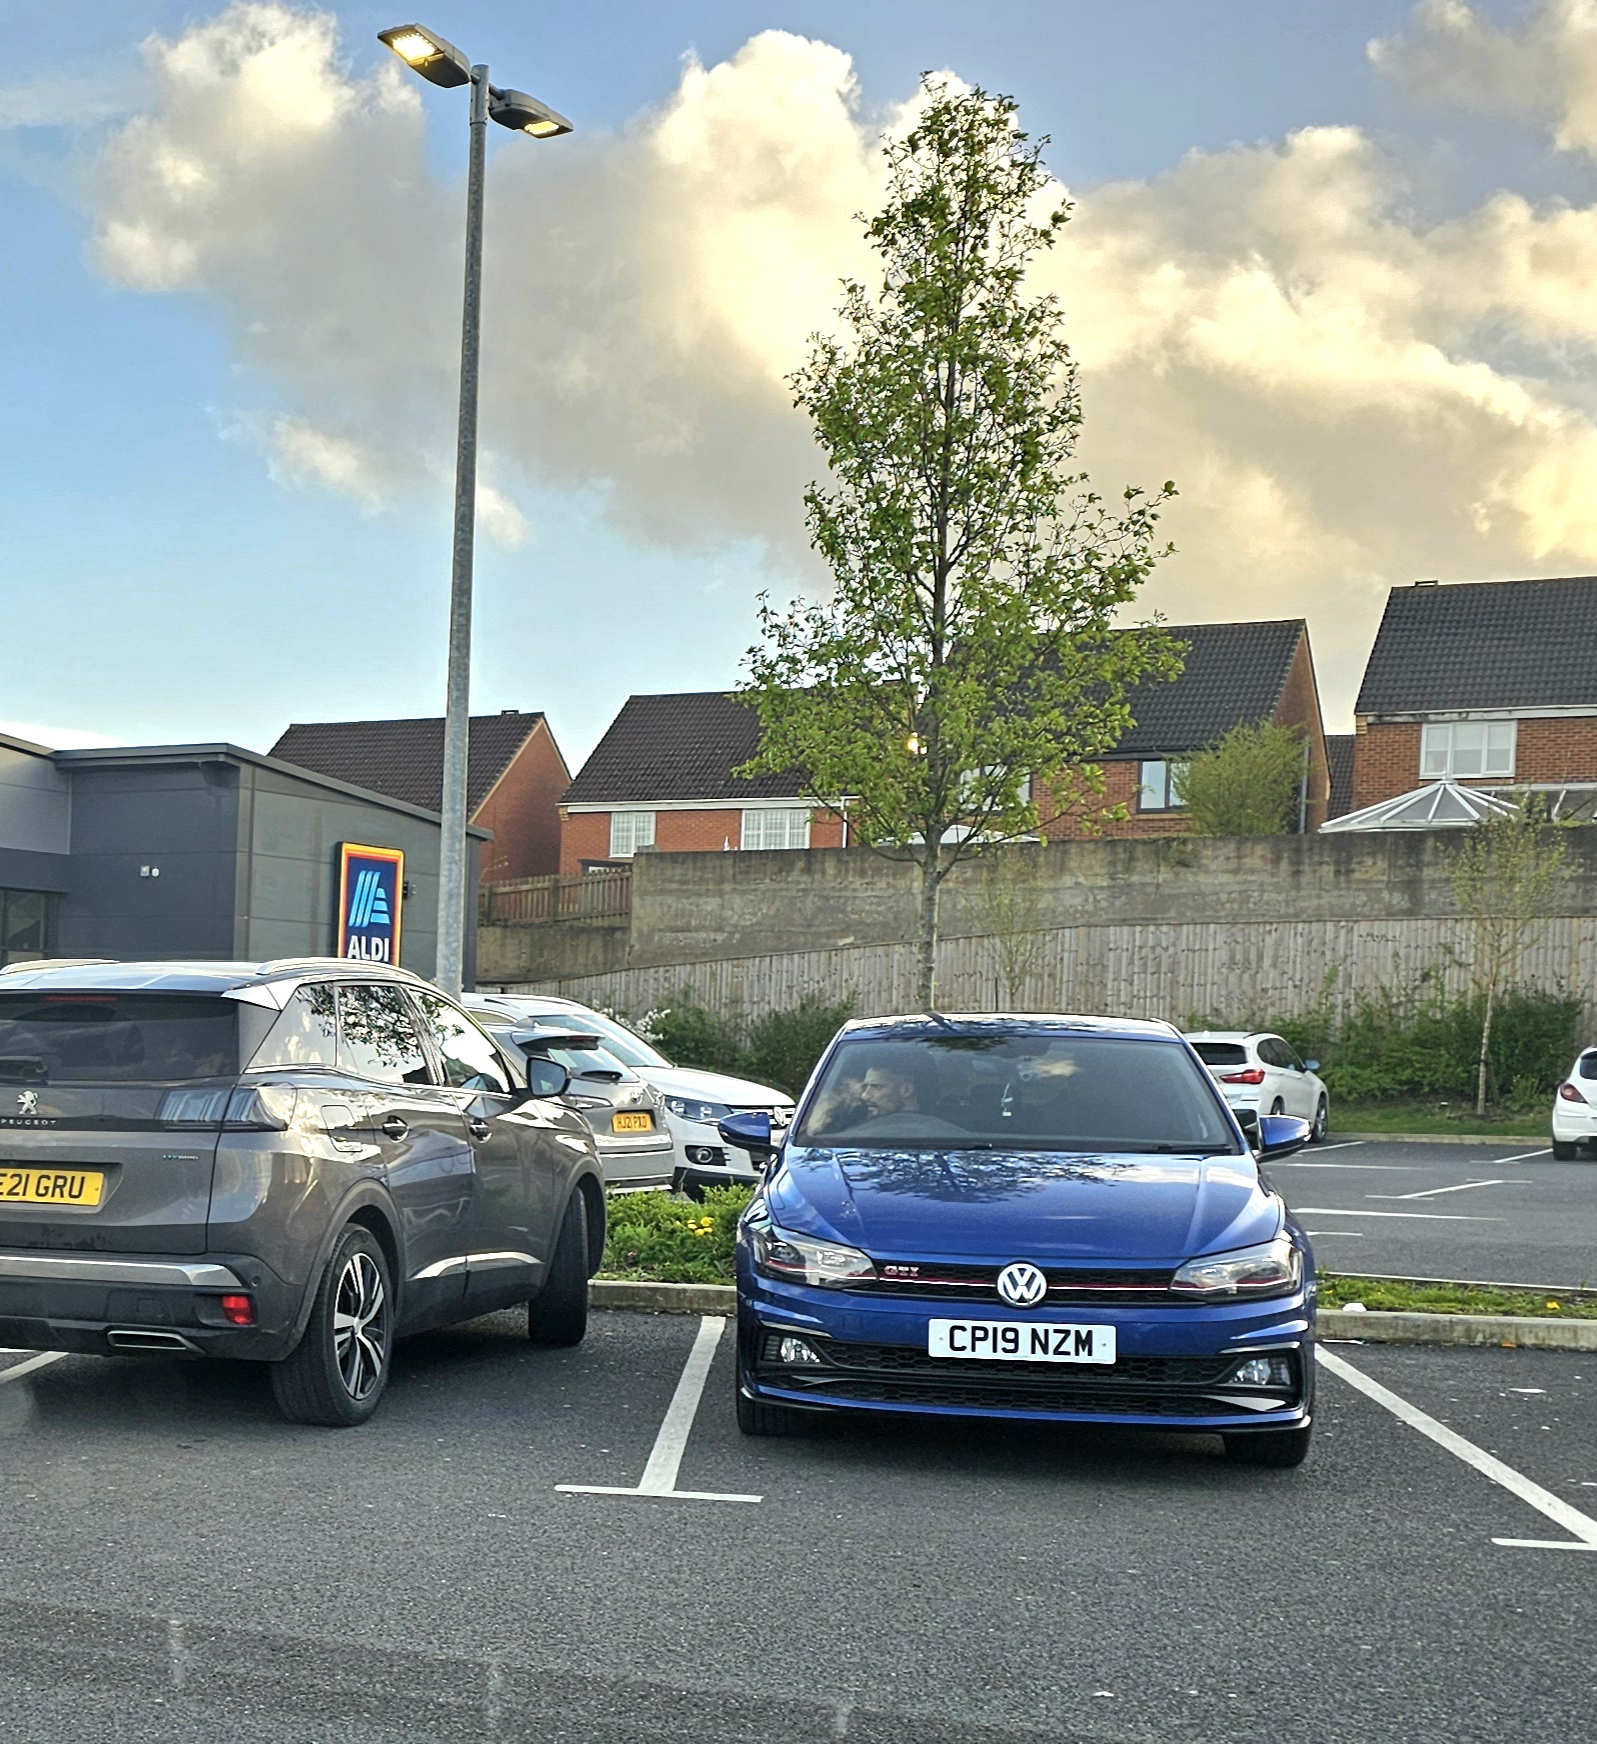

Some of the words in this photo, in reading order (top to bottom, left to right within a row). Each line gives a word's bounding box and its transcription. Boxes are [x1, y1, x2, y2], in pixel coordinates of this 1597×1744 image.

[346, 934, 391, 962] ALDI
[0, 1118, 57, 1126] PEUGEOT
[34, 1176, 86, 1199] GRU
[884, 1265, 920, 1277] GTI
[949, 1324, 1020, 1354] CP19
[1030, 1327, 1094, 1357] NZM
